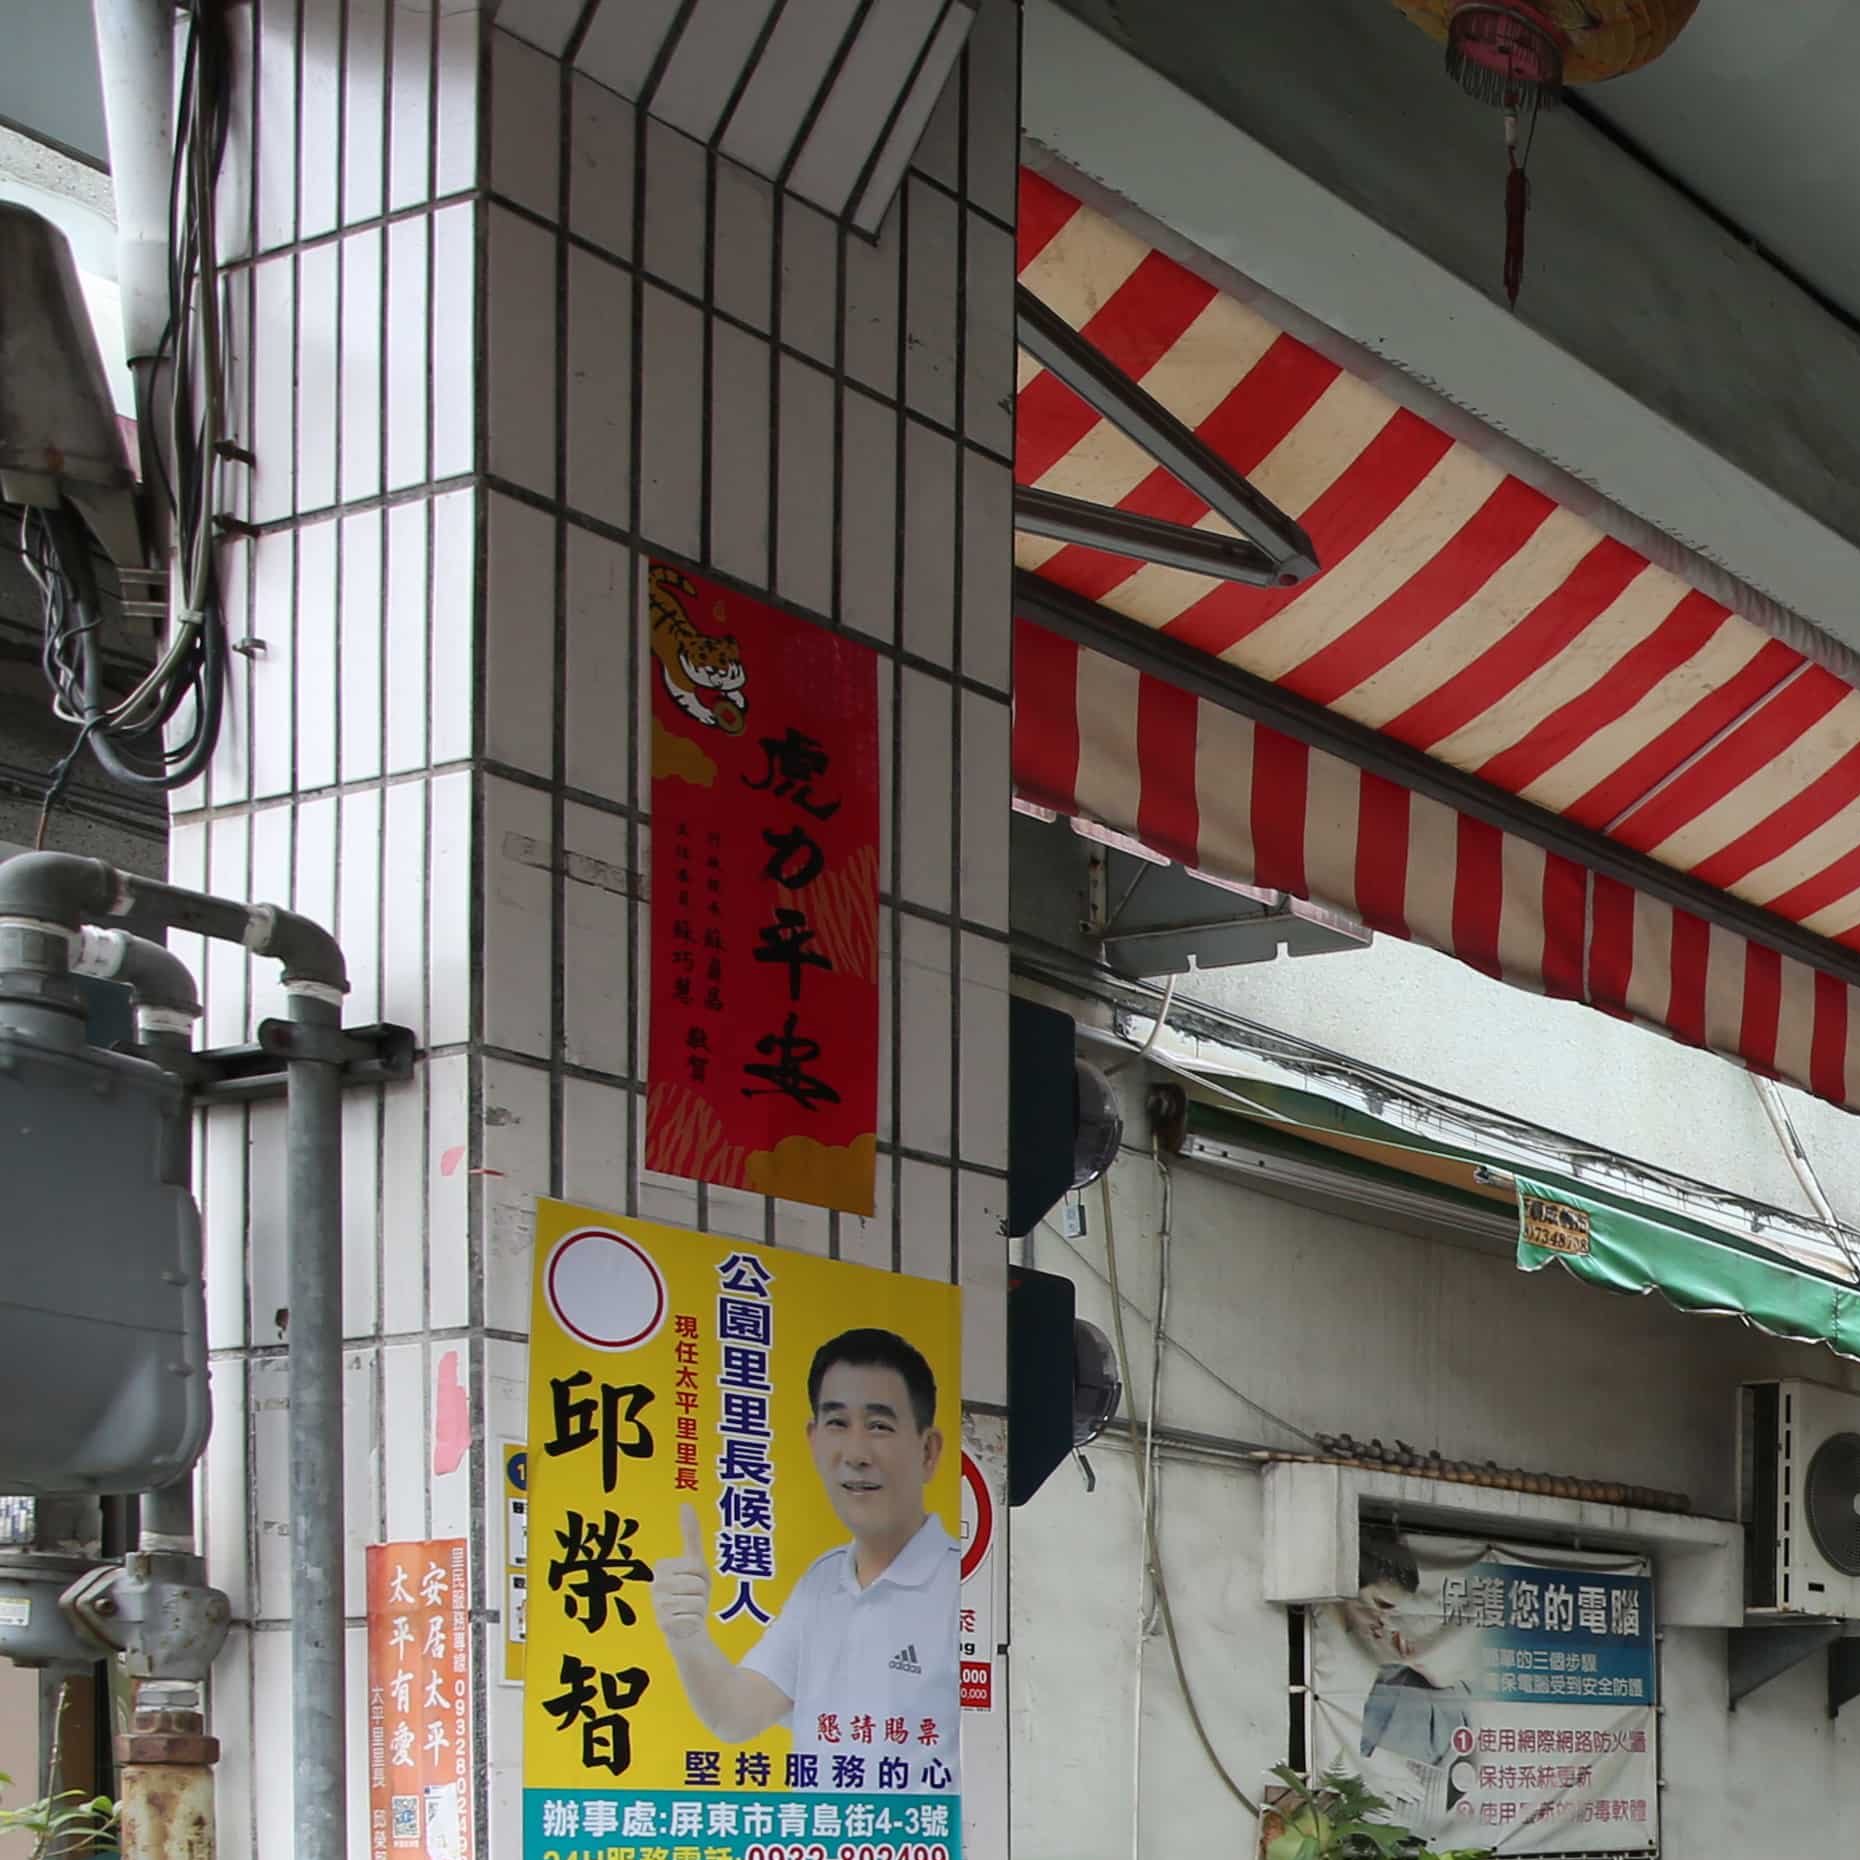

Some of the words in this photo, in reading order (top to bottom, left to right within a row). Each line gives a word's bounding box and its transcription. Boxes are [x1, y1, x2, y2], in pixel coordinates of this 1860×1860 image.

[740, 727, 842, 1111] 虎力平安
[674, 1314, 699, 1492] 現任太平里里長
[717, 1252, 774, 1626] 公園里里長候選人
[388, 1564, 417, 1767] 太平有愛
[419, 1560, 451, 1767] 安居太平
[541, 1369, 656, 1777] 邱榮智
[1442, 1576, 1640, 1636] 保護您的電腦
[542, 1799, 950, 1839] 辦事處:屏東市青島街4-3號
[684, 1750, 953, 1790] 堅持服務的心
[815, 1712, 942, 1746] 懇請賜票
